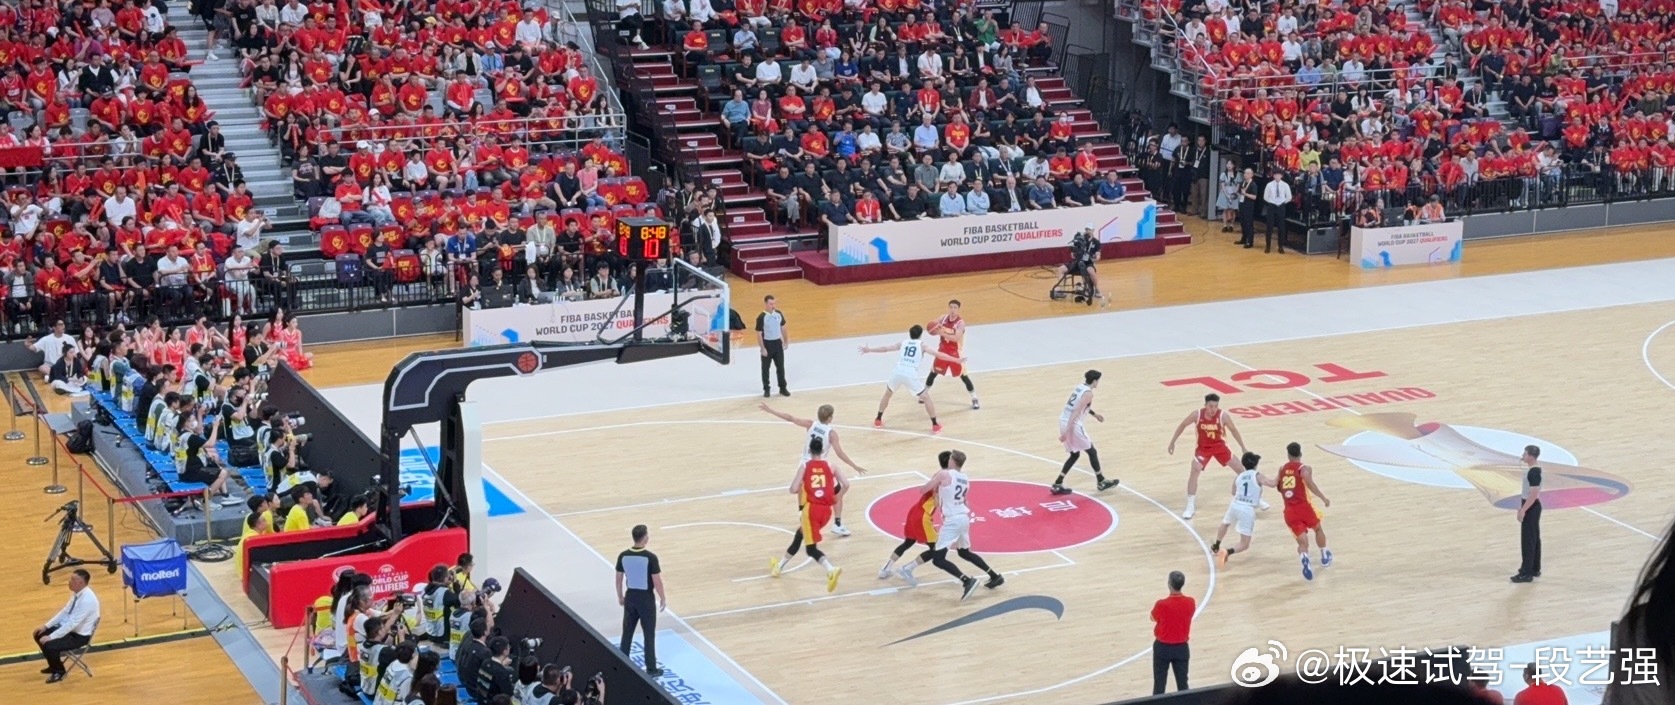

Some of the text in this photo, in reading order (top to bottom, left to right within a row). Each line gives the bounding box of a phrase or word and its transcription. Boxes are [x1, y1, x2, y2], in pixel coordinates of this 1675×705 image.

[964, 221, 1039, 235] FIBA BASKETBALL
[940, 228, 1063, 247] WORLD CUP 2027 QUALIFIERS
[560, 314, 582, 324] FIBA
[535, 325, 567, 336] WORLD
[569, 323, 588, 333] CUP
[904, 346, 917, 357] 18
[1160, 362, 1389, 395] TCL
[1228, 387, 1437, 419] QUALIFIERS
[810, 474, 826, 488] 21
[1243, 481, 1249, 496] 1
[141, 568, 180, 581] molten
[372, 577, 392, 585] ORLD
[394, 574, 409, 582] CUP
[370, 581, 409, 593] UALIFIERS
